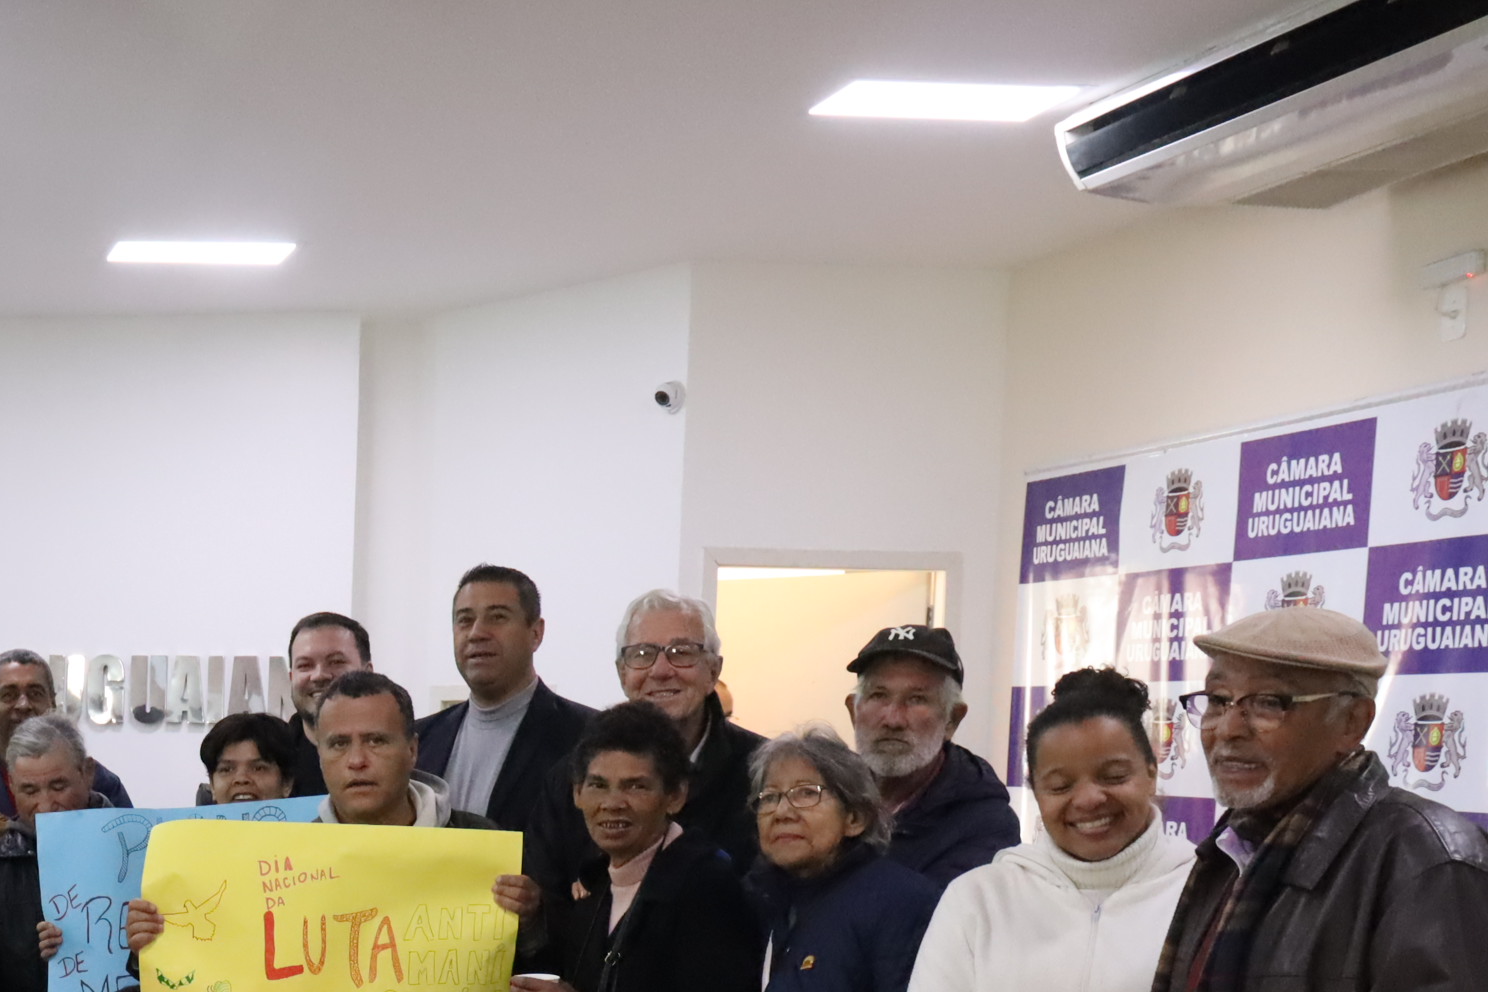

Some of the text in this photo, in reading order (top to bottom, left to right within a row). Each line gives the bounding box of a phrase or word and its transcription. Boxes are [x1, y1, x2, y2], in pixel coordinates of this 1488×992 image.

[1266, 451, 1343, 485] CÂMARA
[1045, 493, 1100, 519] CÂMARA
[1252, 479, 1354, 513] MUNICIPAL
[1036, 516, 1107, 543] MUNICIPAL
[1247, 504, 1356, 539] URUGUAIANA
[1033, 538, 1109, 564] URUGUAIANA
[1398, 565, 1488, 596] CÂMARA
[1142, 590, 1203, 615] CÂMARA
[1382, 596, 1488, 626] MUNICIPA
[1131, 615, 1212, 639] MUNICIPAL
[1376, 623, 1488, 654] URUGUAIAN
[262, 866, 341, 894] NACIONAL
[48, 883, 83, 922] DE
[265, 896, 286, 911] DA
[263, 907, 404, 989] LUTA
[57, 950, 89, 979] DE
